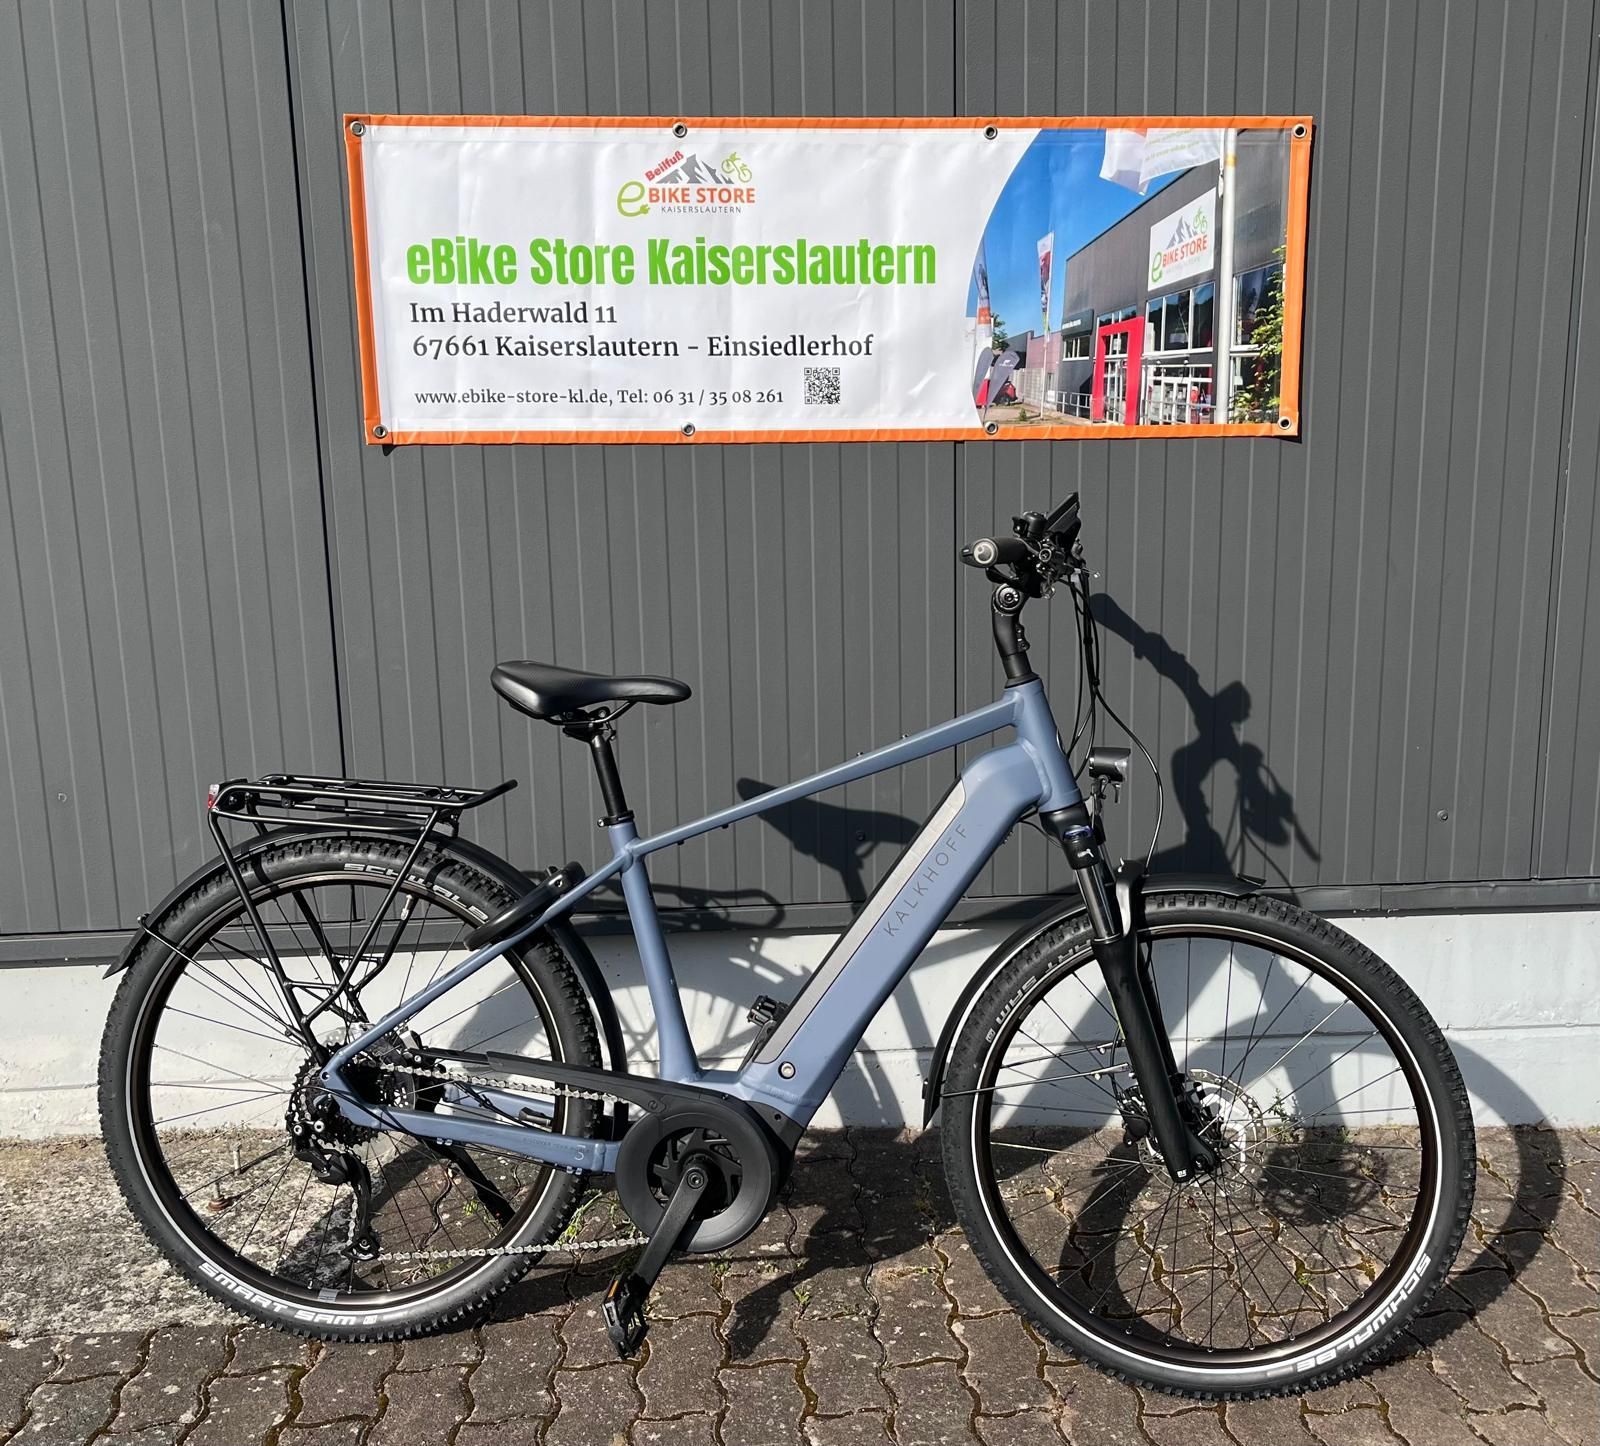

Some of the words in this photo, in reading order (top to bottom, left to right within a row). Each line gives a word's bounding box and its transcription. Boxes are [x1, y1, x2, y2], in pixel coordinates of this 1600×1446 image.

[644, 150, 685, 181] Beilfuß
[661, 205, 742, 214] KAISERSLAUTERN
[696, 187, 756, 204] STORE
[406, 236, 518, 285] eBike
[529, 238, 635, 285] Store
[647, 237, 937, 285] Kaiserslautern
[1179, 234, 1208, 263] STORE
[409, 302, 446, 324] Im
[451, 301, 588, 324] Haderwald
[594, 305, 618, 324] 11
[412, 335, 490, 361] 67661
[495, 334, 680, 357] Kaiserslautern
[707, 333, 874, 357] Einsiedlerhof
[414, 388, 613, 406] www.ebike-store-kl.de,
[617, 389, 649, 404] Tel:
[652, 389, 674, 404] 06
[678, 390, 695, 406] 31
[709, 390, 728, 406] 35
[731, 389, 752, 404] 08
[756, 390, 784, 404] 261
[343, 862, 490, 922] SCHWALB
[883, 823, 968, 937] KALKHOFF
[198, 1261, 289, 1313] SMART
[294, 1310, 357, 1326] SAM
[1296, 1253, 1432, 1373] SCHWALBE
